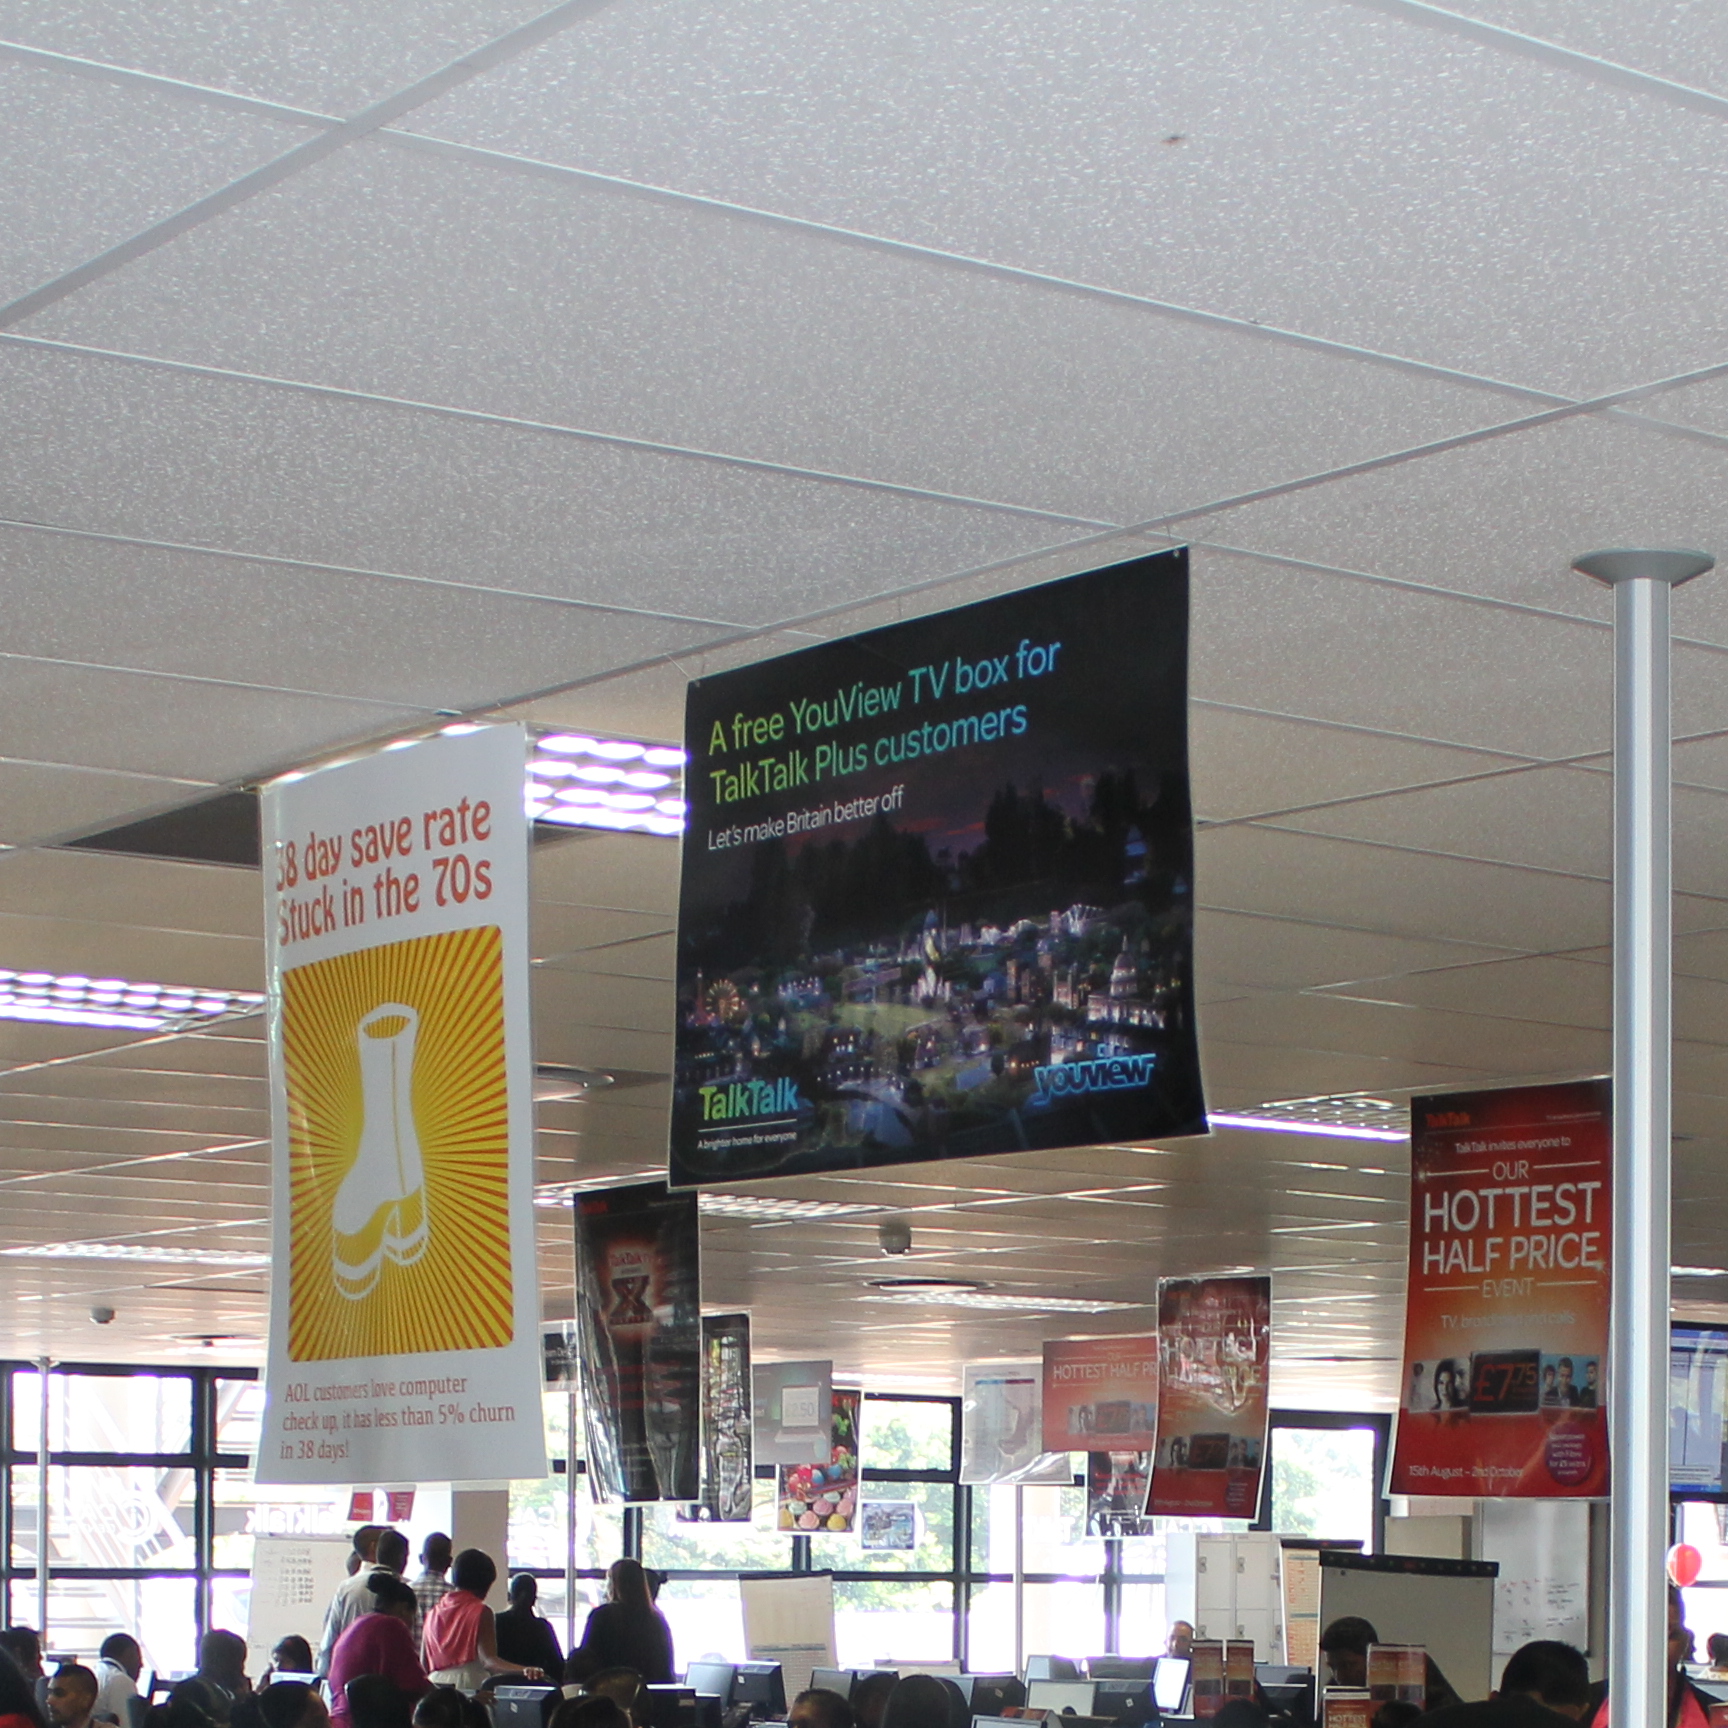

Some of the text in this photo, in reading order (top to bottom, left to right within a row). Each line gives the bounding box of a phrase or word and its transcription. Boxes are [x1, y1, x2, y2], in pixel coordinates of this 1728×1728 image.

[709, 638, 1061, 756] A free YouView TV box for
[709, 704, 1028, 804] TalkTalk Plus customers
[304, 831, 342, 881] day
[350, 815, 413, 868] save
[423, 796, 491, 851] rate
[708, 785, 905, 850] Let's make Britain better off
[278, 853, 493, 946] Stuck in the 70s
[1032, 1045, 1156, 1106] youview
[698, 1076, 799, 1121] TalkTalk
[1517, 1137, 1560, 1151] everyone
[1561, 1136, 1571, 1147] to
[1492, 1160, 1529, 1181] OUR
[1424, 1181, 1602, 1233] HOTTEST
[1423, 1231, 1601, 1275] HALF PRICE
[1482, 1277, 1535, 1298] EVENT
[285, 1377, 468, 1402] AOL customers love computer
[1053, 1362, 1140, 1380] HOTTEST HALF
[282, 1411, 318, 1432] check
[342, 1411, 351, 1429] it
[352, 1408, 372, 1428] has
[374, 1407, 398, 1428] less
[401, 1405, 434, 1427] than
[437, 1402, 466, 1426] 5%
[468, 1402, 516, 1422] churn
[280, 1438, 350, 1464] in 38 days!
[1408, 1465, 1430, 1477] 15th
[1431, 1465, 1463, 1480] August
[1489, 1466, 1524, 1478] October
